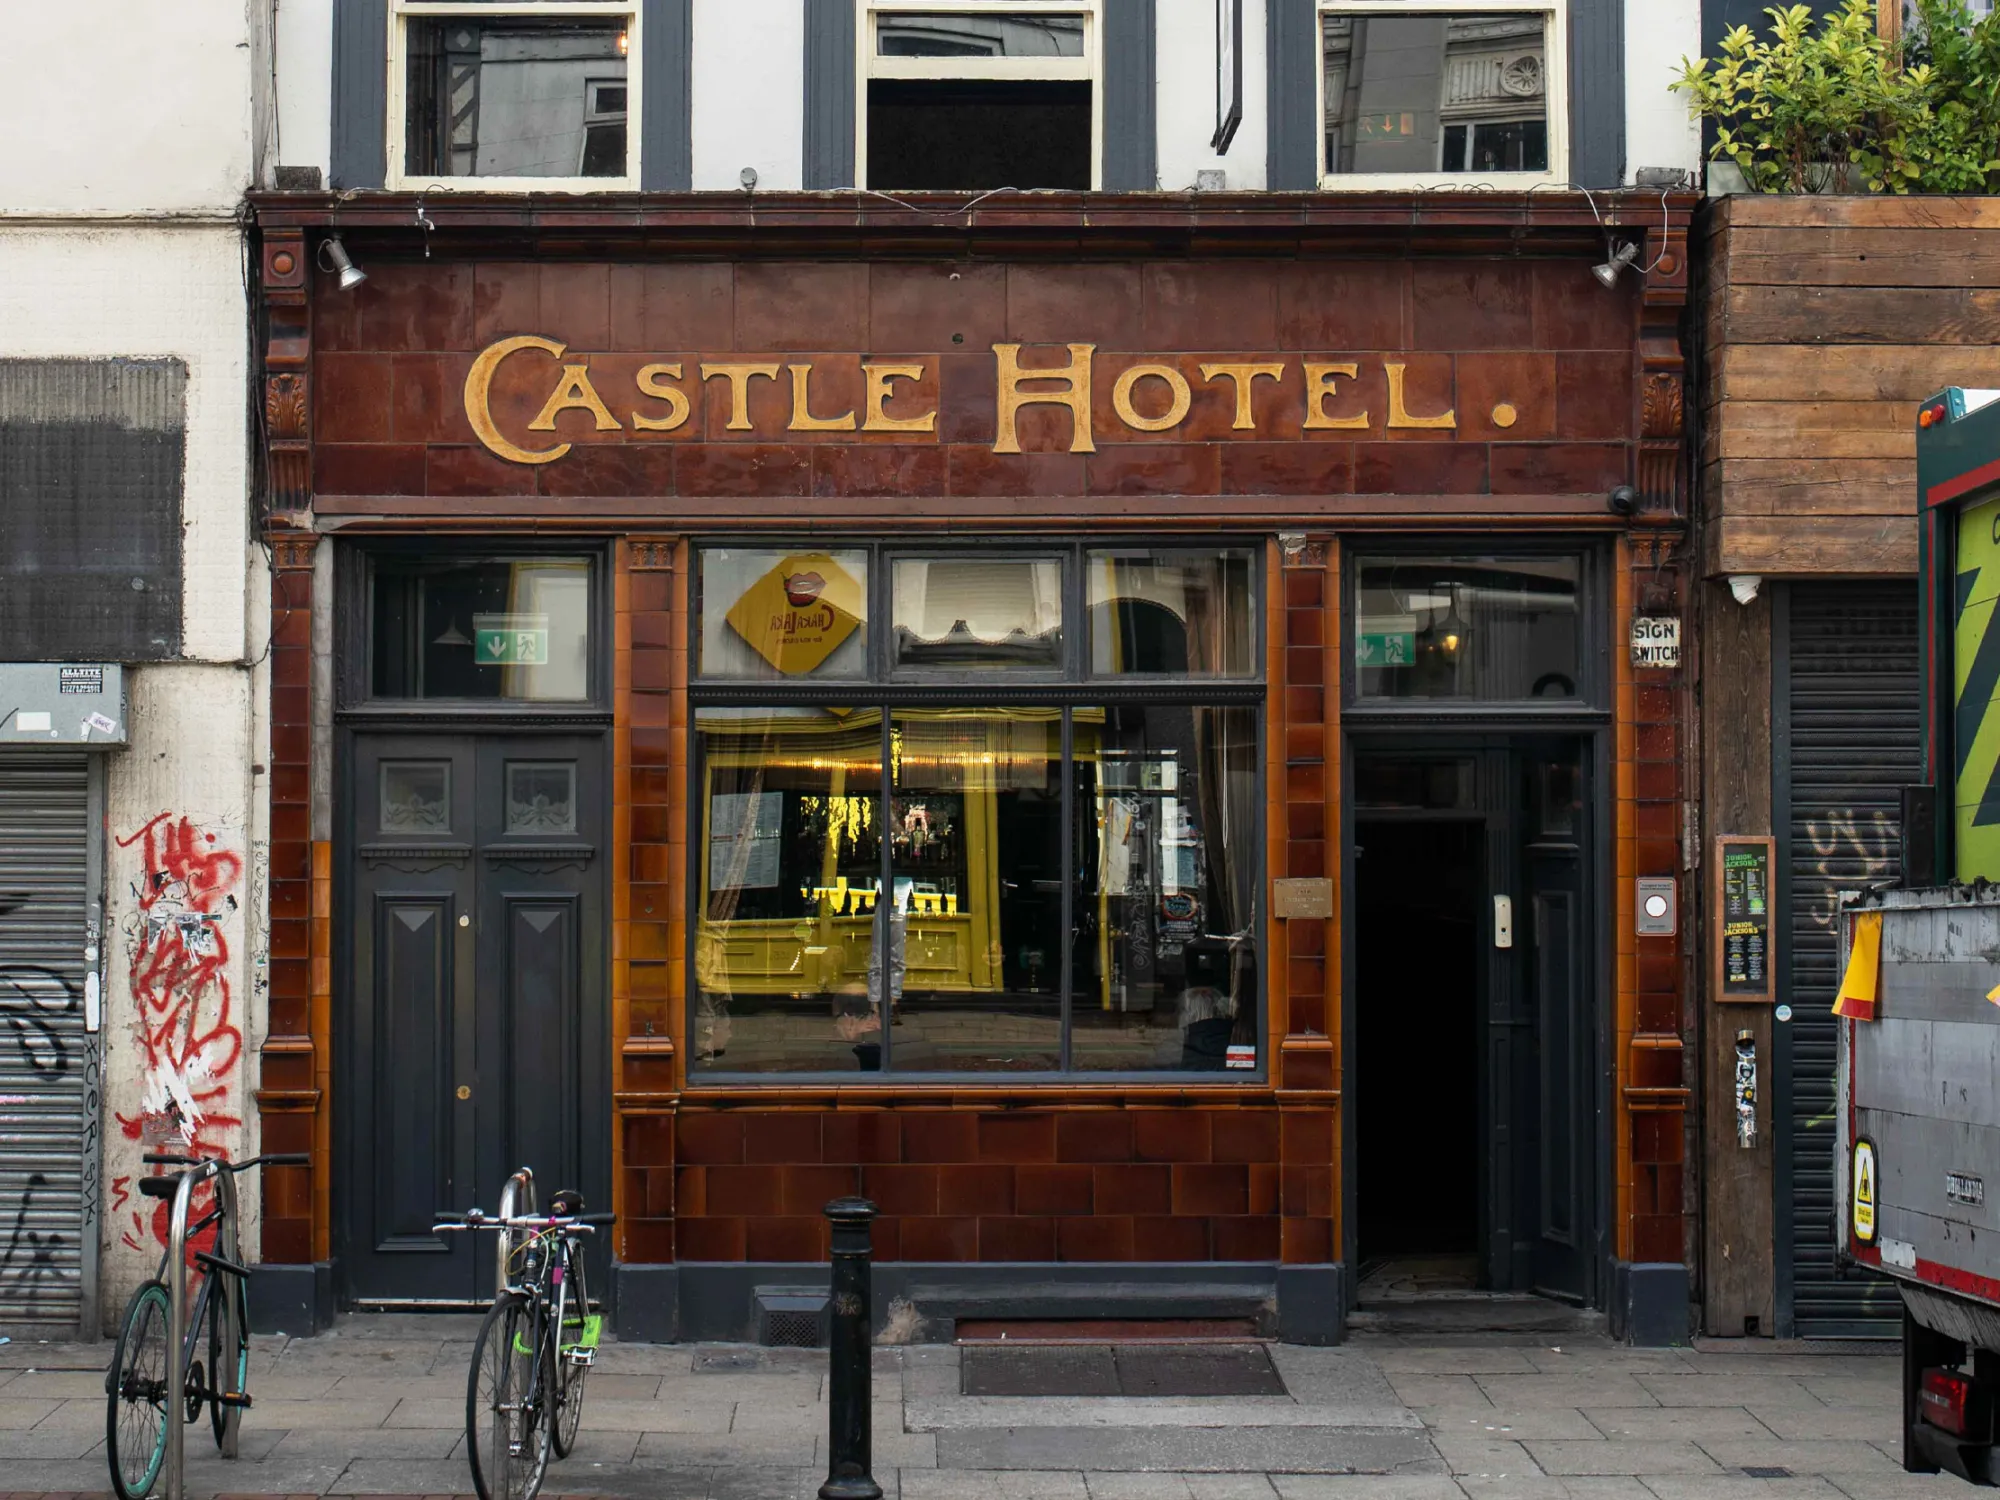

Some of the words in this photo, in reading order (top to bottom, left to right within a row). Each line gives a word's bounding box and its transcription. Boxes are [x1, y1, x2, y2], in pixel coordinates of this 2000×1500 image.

[464, 336, 937, 464] CASTLE
[1634, 624, 1674, 639] SIGN
[1632, 645, 1679, 661] SWITCH
[1726, 853, 1752, 861] JUNIOR
[1727, 921, 1753, 929] JUNIOR
